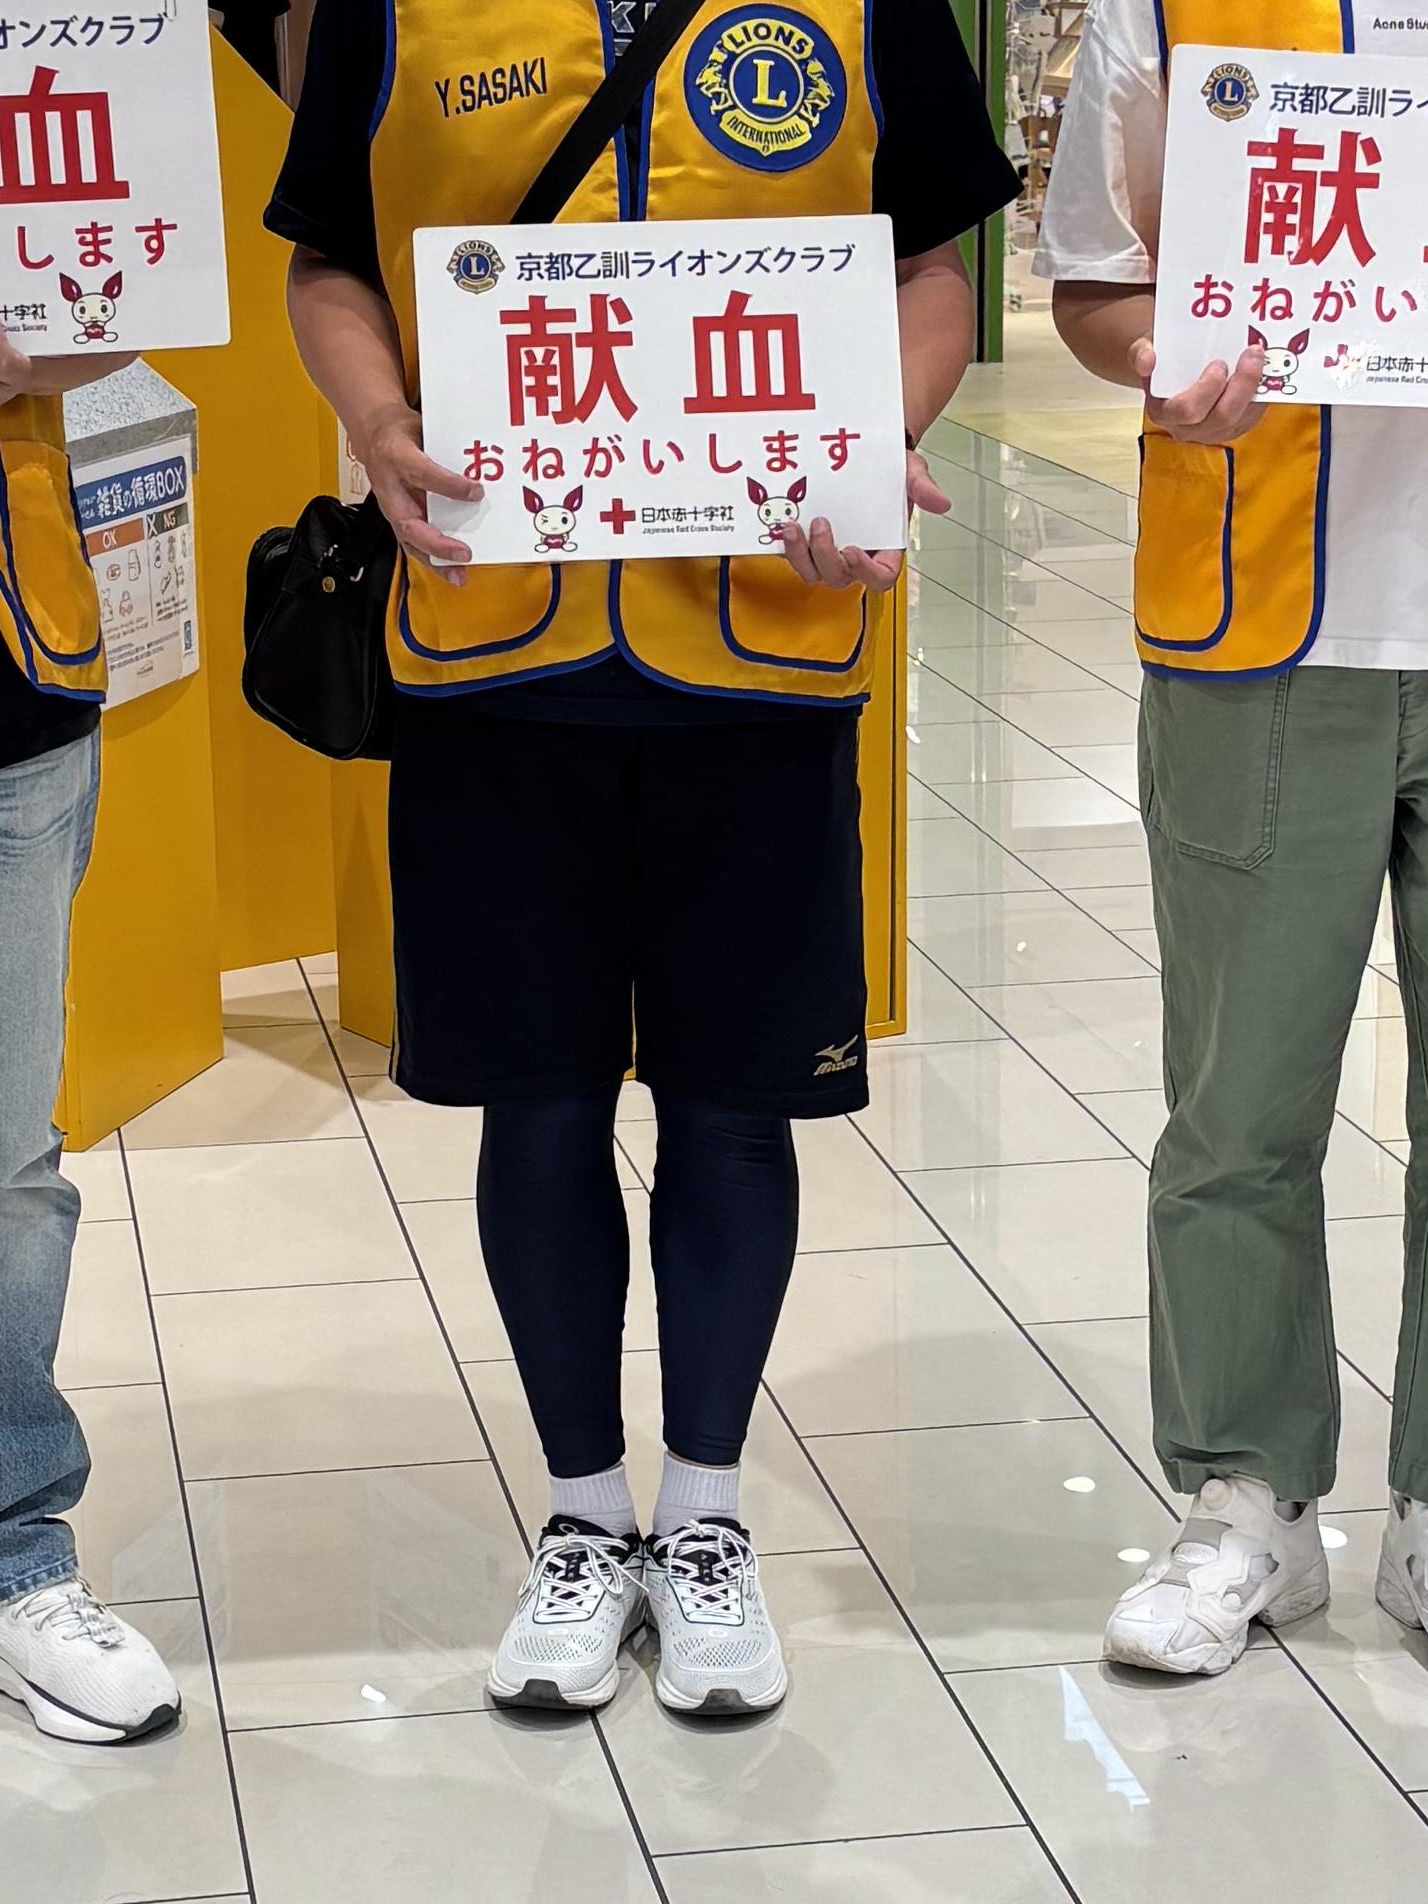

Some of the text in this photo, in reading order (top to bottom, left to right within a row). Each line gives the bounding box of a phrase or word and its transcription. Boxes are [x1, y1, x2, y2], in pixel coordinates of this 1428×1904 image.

[727, 22, 809, 55] LIONS
[434, 57, 548, 118] Y.SASAKI
[752, 59, 788, 108] L
[727, 116, 807, 145] INTERNATIONAL
[515, 243, 855, 282] 京都乙訓ライオンズクラブ
[499, 289, 816, 427] 献血
[462, 427, 861, 483] おねがいします
[641, 505, 735, 524] 日本赤十字社
